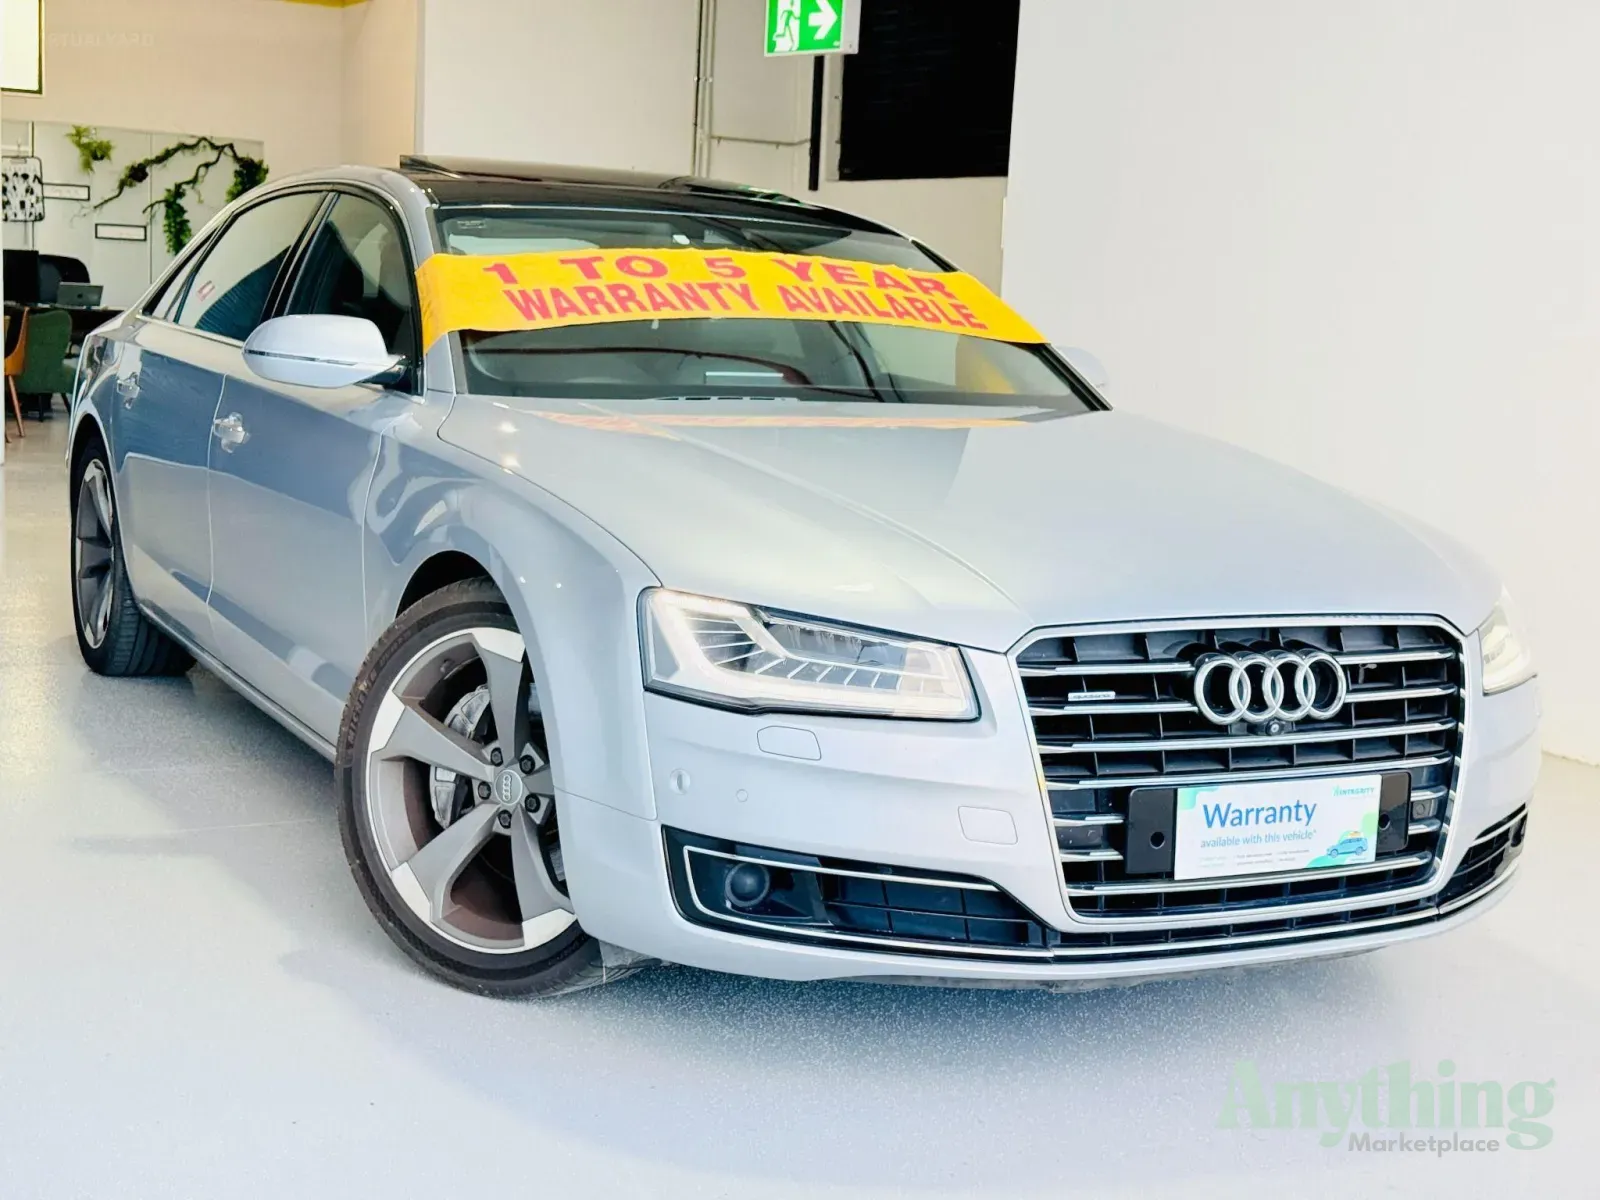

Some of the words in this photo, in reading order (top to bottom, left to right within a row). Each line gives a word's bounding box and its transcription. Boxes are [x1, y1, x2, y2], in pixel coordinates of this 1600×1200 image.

[483, 263, 518, 284] 1
[558, 255, 668, 280] TO
[704, 257, 747, 278] 5
[770, 258, 958, 300] YEAR
[502, 282, 760, 321] WARRANTY
[777, 284, 988, 330] AVAILABLE
[1202, 799, 1317, 828] Warranty
[1200, 836, 1240, 848] available
[1242, 833, 1262, 845] with
[1264, 832, 1280, 843] this
